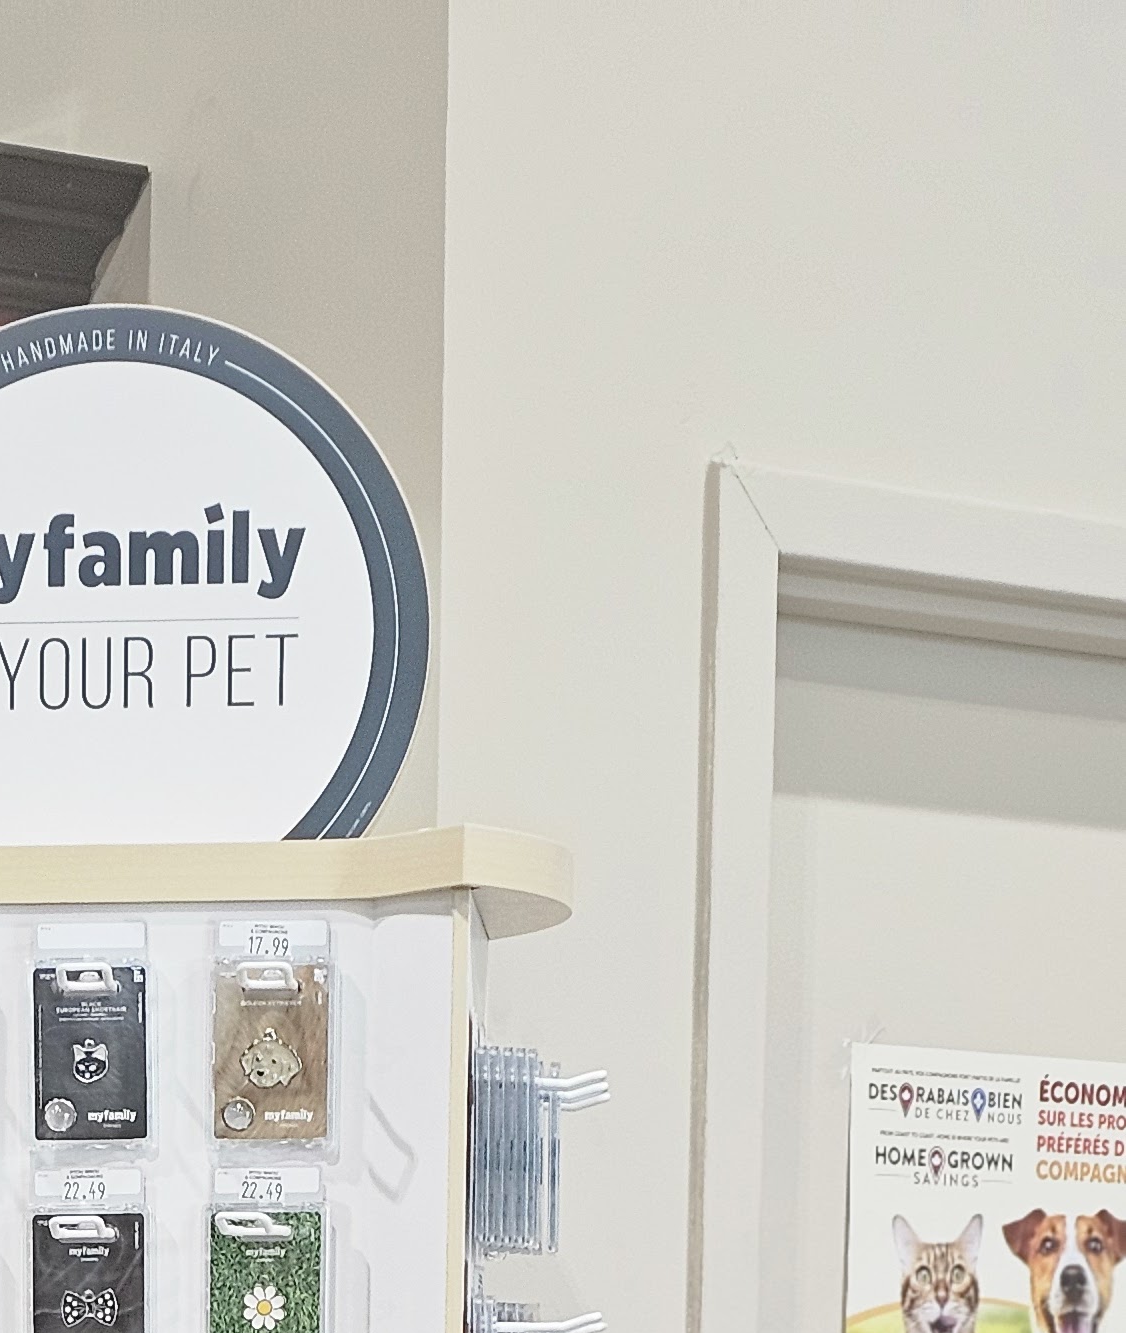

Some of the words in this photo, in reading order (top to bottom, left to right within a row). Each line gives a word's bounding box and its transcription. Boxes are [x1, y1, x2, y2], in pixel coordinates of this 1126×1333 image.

[0, 329, 116, 373] HANDMADE
[128, 329, 148, 351] IN
[159, 332, 220, 366] ITALY
[185, 633, 299, 708] PET
[249, 936, 289, 956] 17.99
[868, 1082, 898, 1101] DES
[916, 1086, 970, 1106] RABAIS
[987, 1091, 1023, 1110] BIEN
[88, 1109, 136, 1123] myfamily
[264, 1108, 313, 1122] myfamily
[915, 1107, 930, 1119] DE
[936, 1108, 970, 1121] CHEZ
[987, 1113, 1022, 1125] NOUS
[1038, 1110, 1066, 1127] SUR
[1070, 1112, 1094, 1129] LES
[1098, 1114, 1126, 1130] PRO
[1036, 1131, 1109, 1156] PRÉFÉRÉS
[875, 1146, 927, 1167] HOME
[947, 1150, 1013, 1173] GROWN
[913, 1171, 979, 1188] SAVINGS
[64, 1181, 105, 1200] 22.49
[242, 1181, 282, 1201] 22.49
